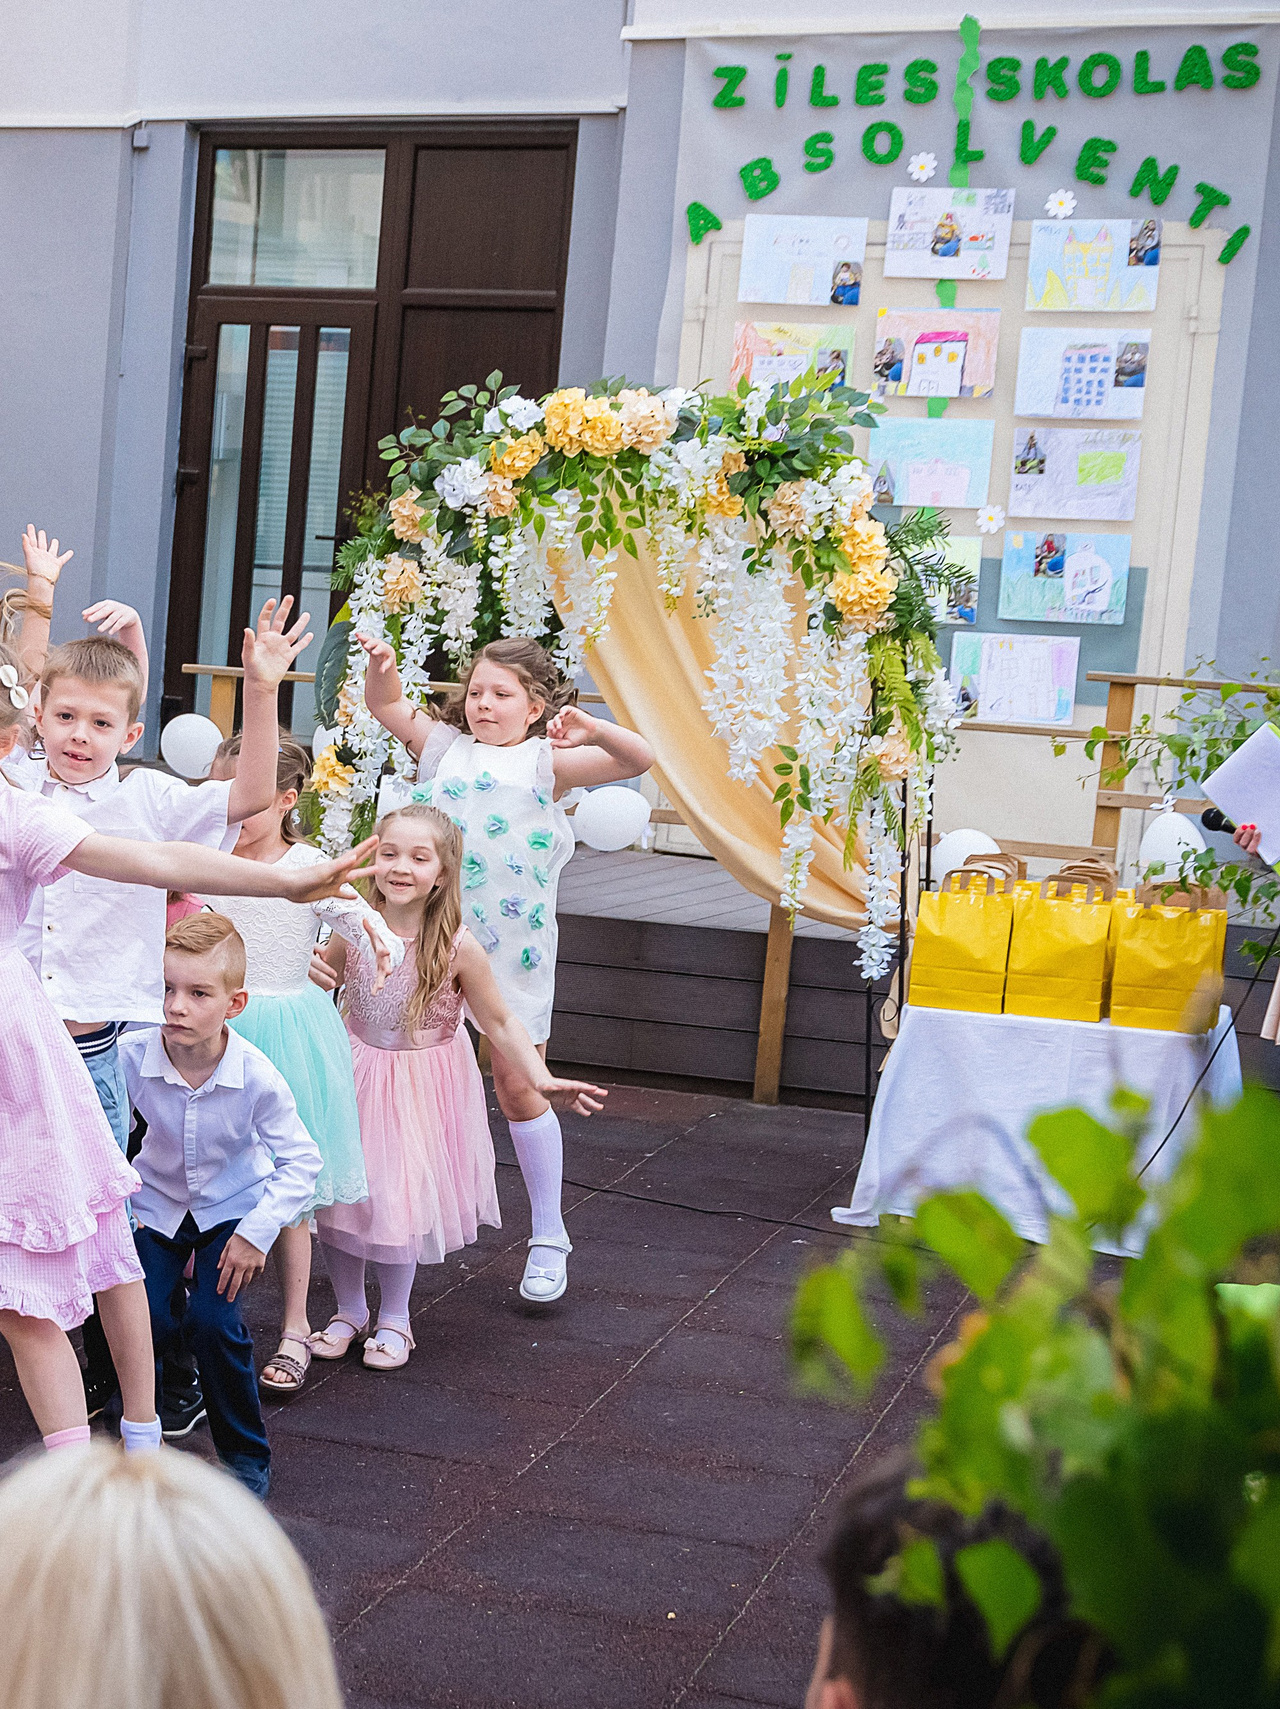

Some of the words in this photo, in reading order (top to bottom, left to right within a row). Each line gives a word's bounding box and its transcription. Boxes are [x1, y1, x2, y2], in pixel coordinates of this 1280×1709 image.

[713, 53, 939, 108] ZĪLES
[986, 42, 1261, 102] SKOLAS
[686, 119, 1251, 265] ABSOLVENTI
